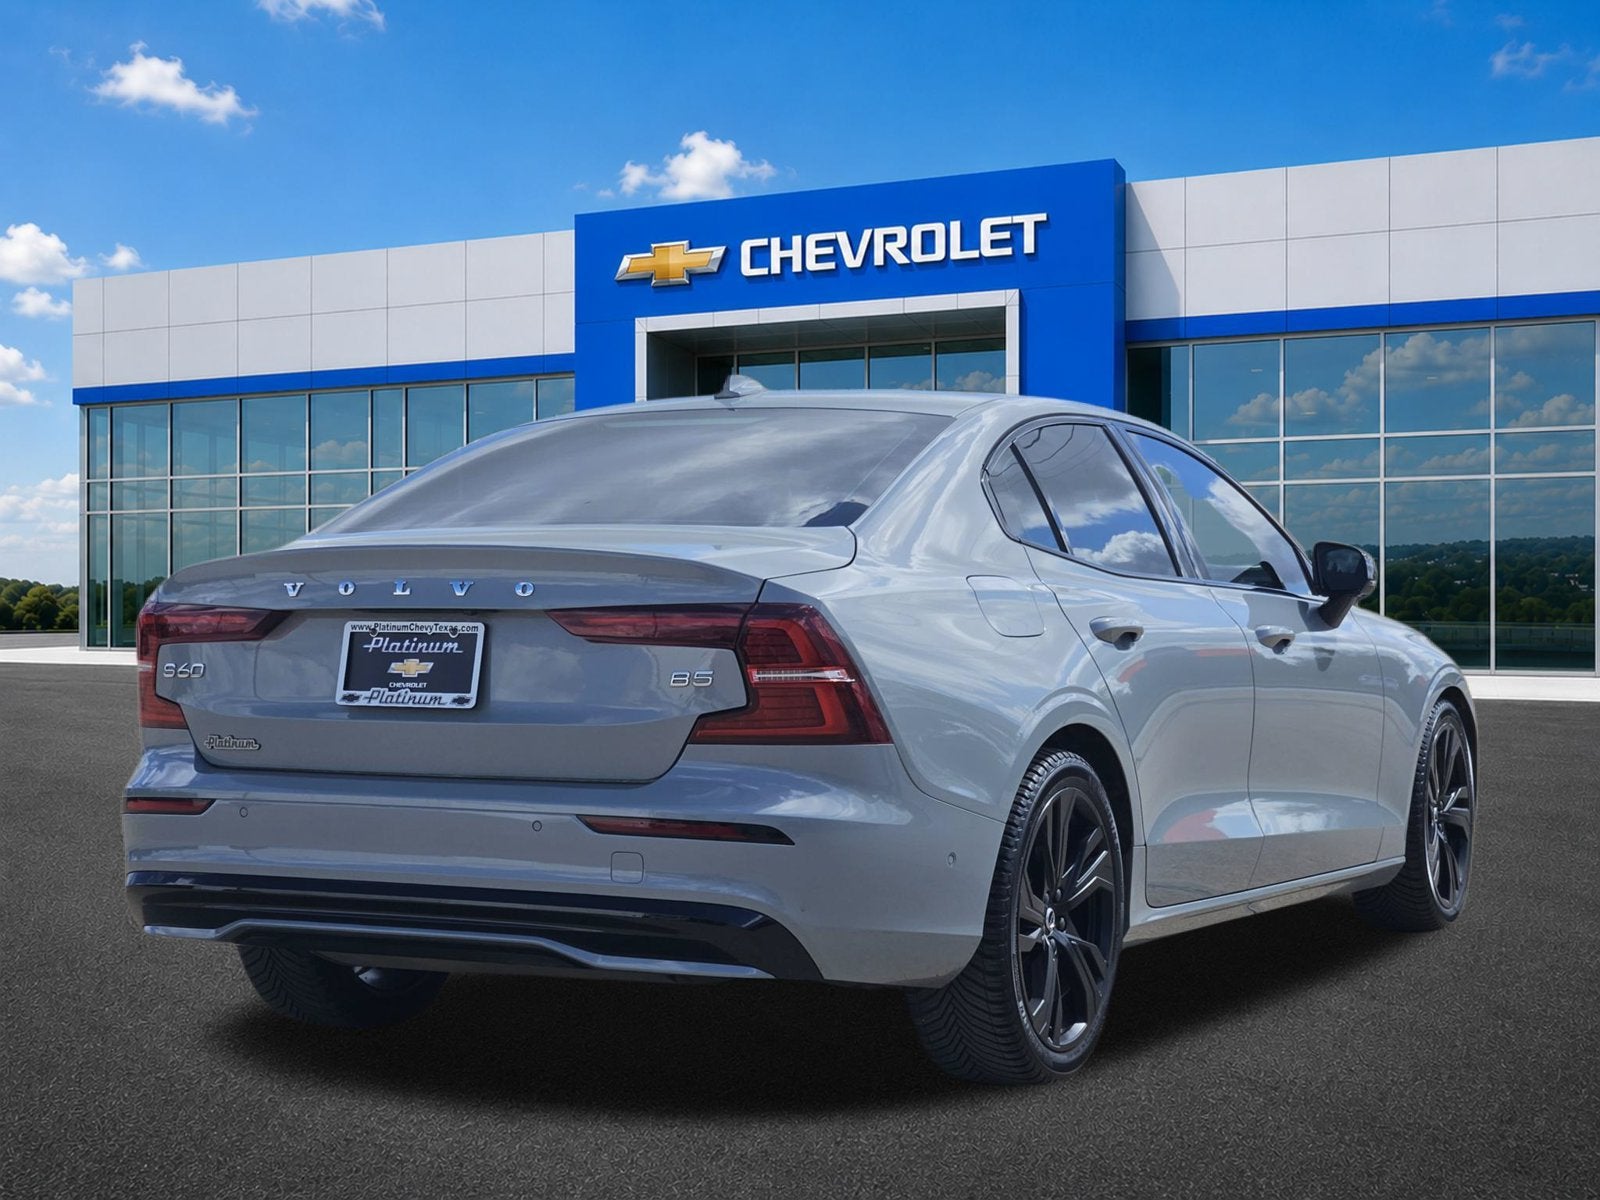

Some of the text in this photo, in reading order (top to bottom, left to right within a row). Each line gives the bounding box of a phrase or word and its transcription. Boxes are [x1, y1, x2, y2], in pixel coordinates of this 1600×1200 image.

[741, 212, 1048, 277] CHEVROLET
[284, 581, 534, 597] VOLVO
[350, 622, 479, 635] wwwPlatinumChevyTexas.com
[363, 636, 463, 653] Platinum
[163, 662, 205, 678] S60
[670, 670, 714, 687] B5
[363, 689, 447, 706] Platinum
[204, 735, 260, 750] Platinum
